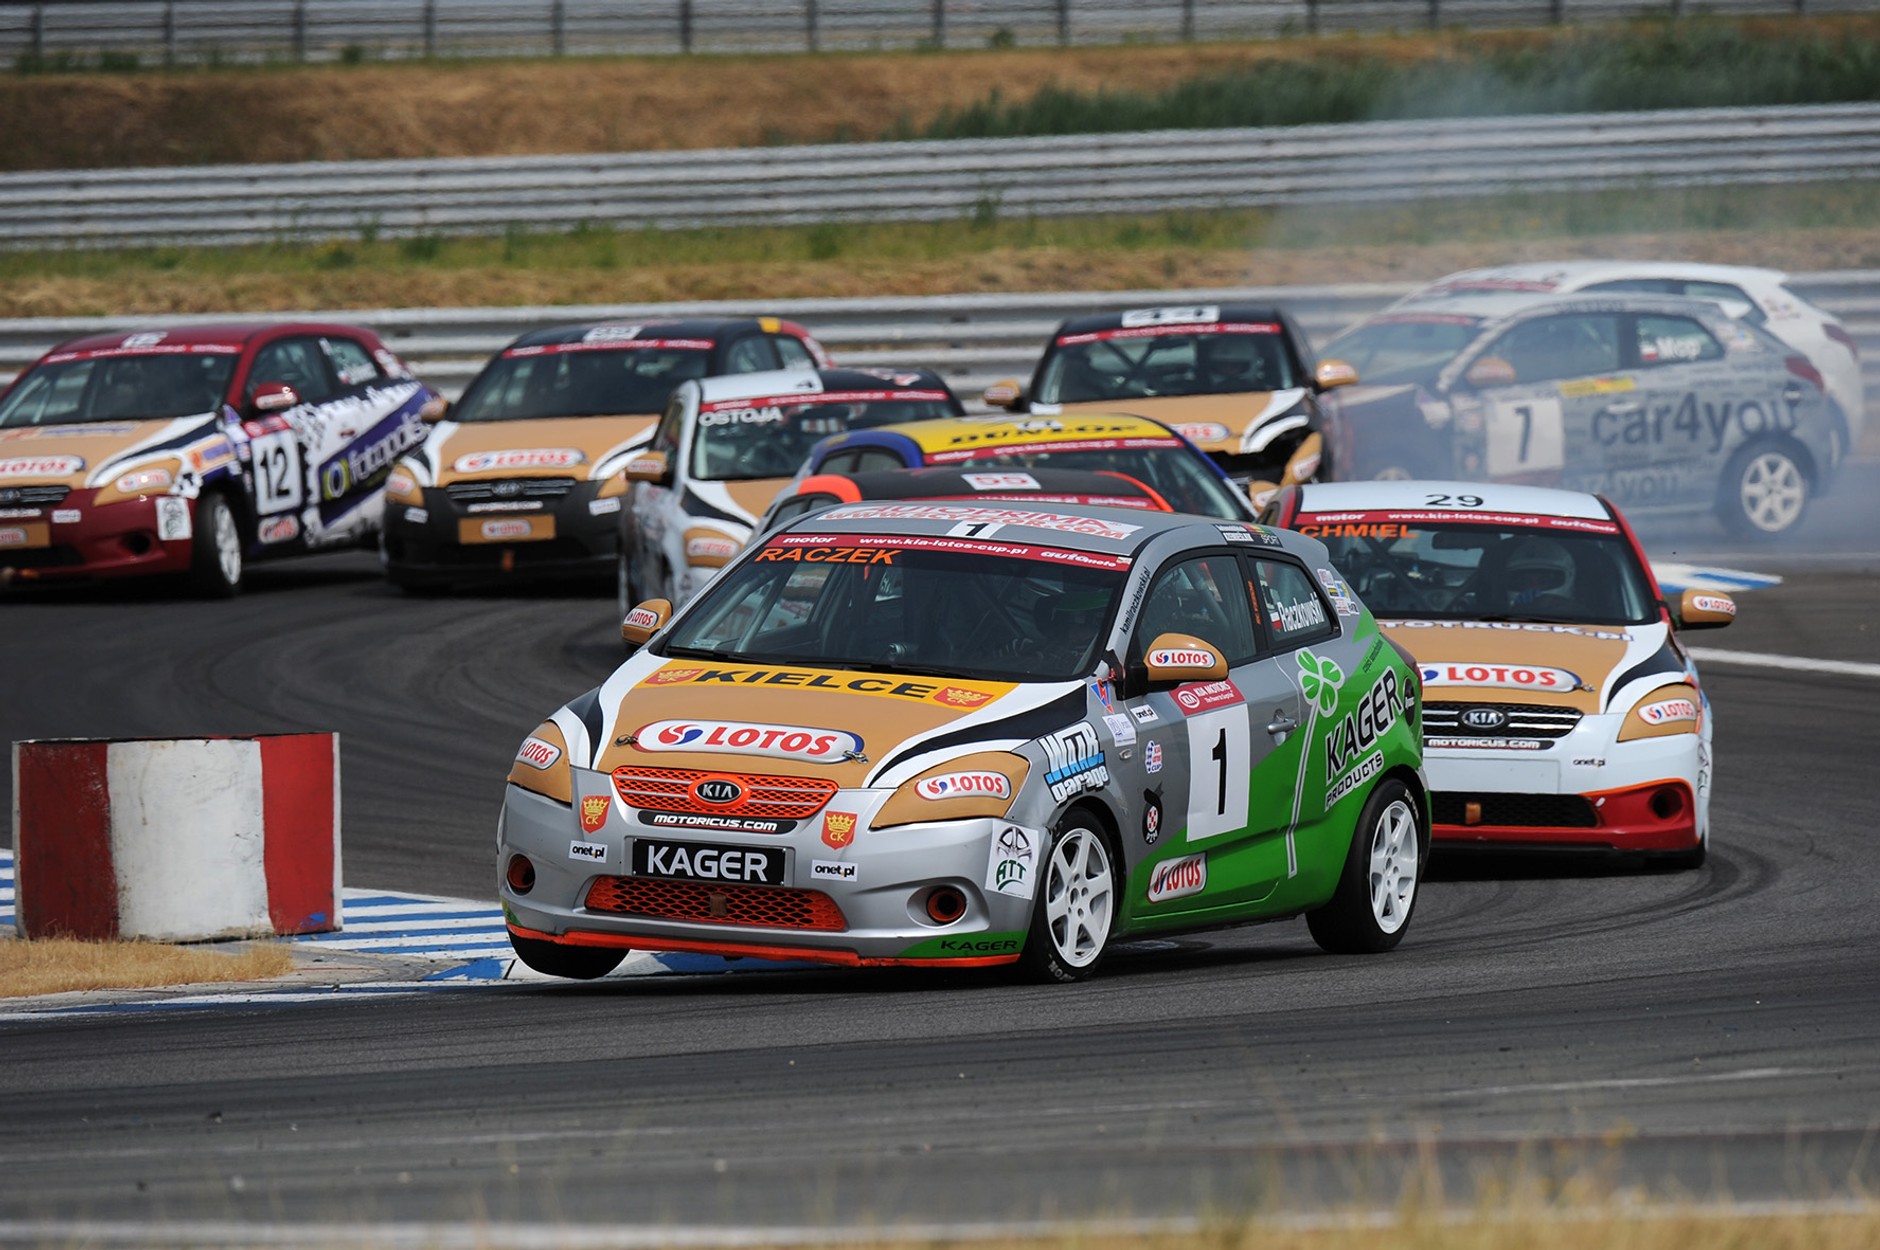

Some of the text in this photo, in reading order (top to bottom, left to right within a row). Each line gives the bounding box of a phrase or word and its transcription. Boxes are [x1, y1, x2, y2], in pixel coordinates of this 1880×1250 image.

[699, 407, 783, 427] OSTOJA
[1591, 392, 1797, 454] car4you
[260, 446, 290, 501] 12
[1425, 493, 1484, 508] 29
[862, 505, 1111, 530] AUTOPRIMA
[1316, 513, 1365, 521] motor
[1388, 511, 1539, 524] www.kia-lotos-cup.pl
[966, 522, 990, 537] 1
[1300, 524, 1418, 539] CHMIEL
[782, 535, 837, 544] motor
[859, 536, 1028, 556] www.kia-lotos-cup.pl
[755, 547, 902, 565] RACZEK
[1119, 566, 1151, 636] kamilraczkowski.pl
[1709, 599, 1735, 613] LOTOS
[632, 610, 653, 626] LOTOS
[1277, 590, 1326, 633] Raczkowski
[1170, 651, 1208, 665] LOTOS
[693, 670, 939, 699] KIELCE
[1447, 666, 1557, 687] LOTOS
[1469, 711, 1498, 724] KIA
[1662, 703, 1695, 718] LOTOS
[1326, 669, 1402, 781] KAGER
[704, 726, 839, 756] LOTOS
[520, 740, 554, 764] LOTOS
[1212, 727, 1227, 816] 1
[1573, 758, 1606, 767] onet.pl
[951, 775, 1004, 794] LOTOS
[1050, 765, 1110, 806] garage
[1326, 753, 1384, 805] PRODUCTS
[702, 783, 733, 798] KIA
[584, 815, 599, 826] CK
[653, 814, 778, 831] MOTORICUS.COM
[829, 831, 845, 843] CK
[571, 843, 606, 860] onet.pl
[647, 845, 768, 882] KAGER
[814, 863, 856, 878] onet.pl
[1166, 857, 1201, 891] LOTOS
[941, 939, 1018, 951] KAGER
